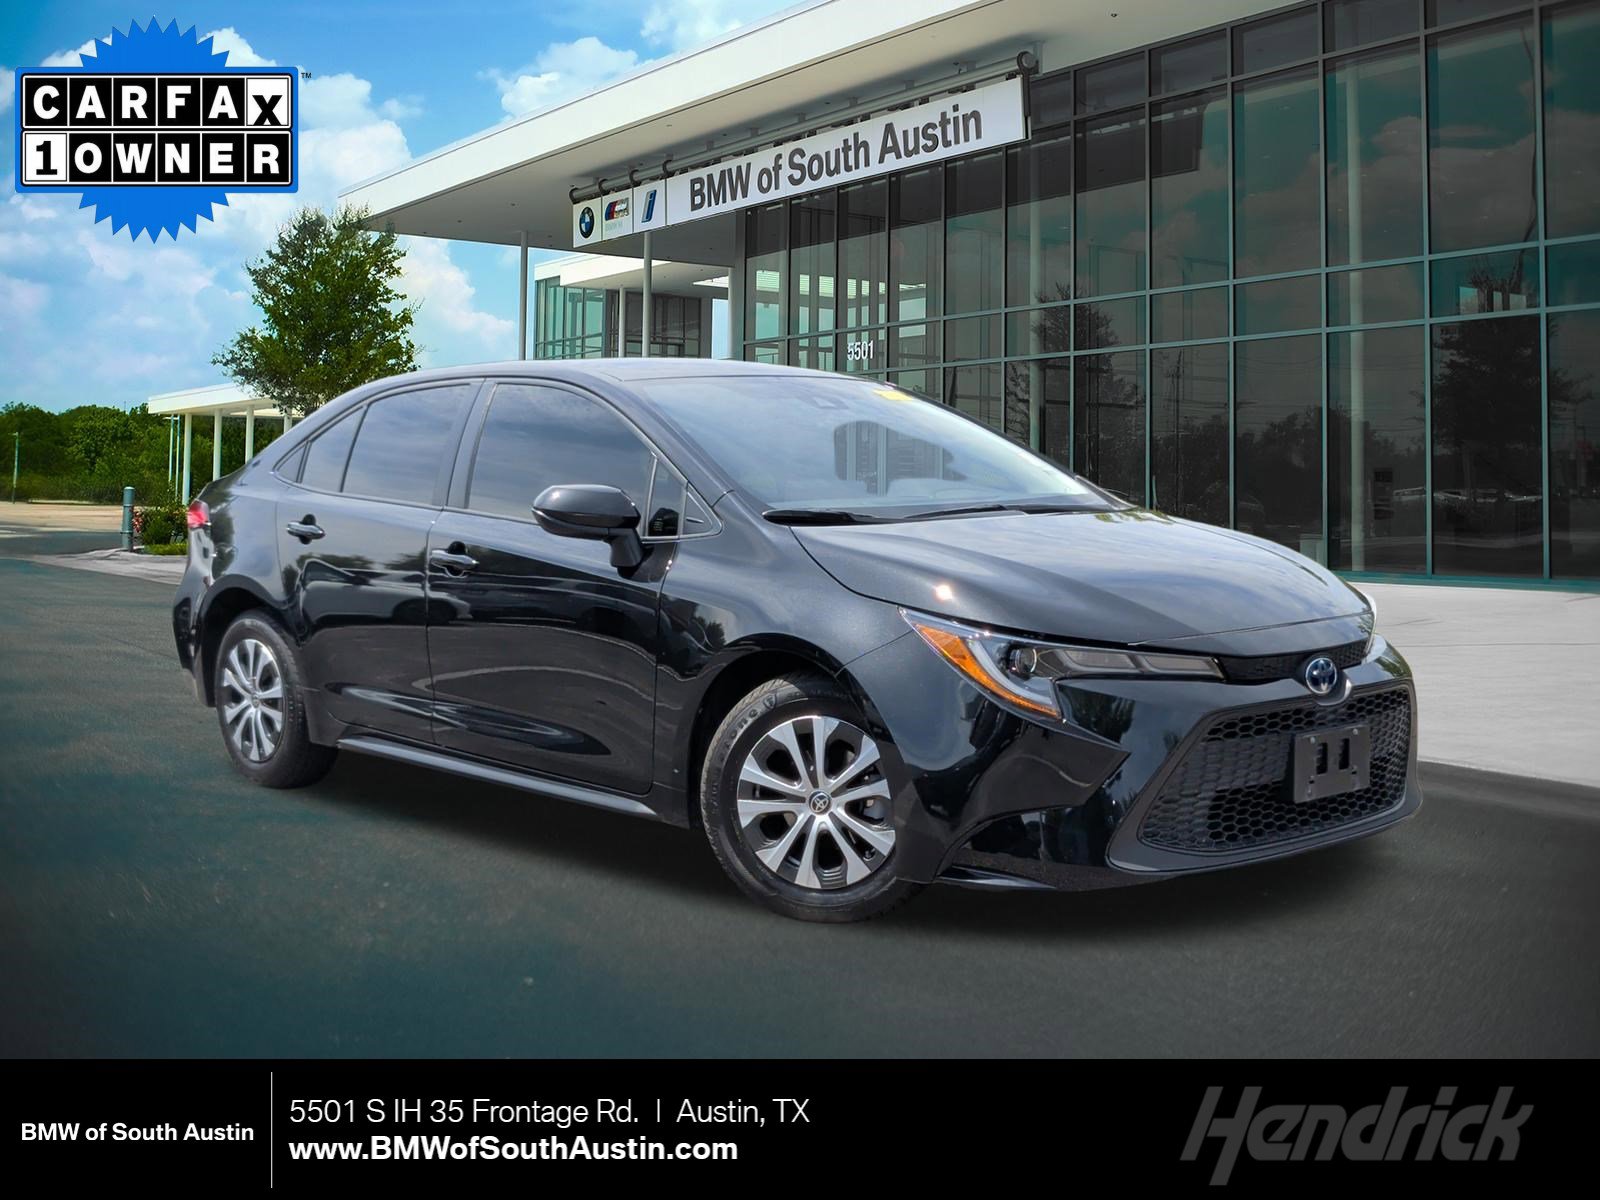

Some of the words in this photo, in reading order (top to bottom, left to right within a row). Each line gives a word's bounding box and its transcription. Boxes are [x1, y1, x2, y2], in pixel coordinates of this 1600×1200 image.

[689, 162, 752, 212] BMW
[757, 153, 783, 194] of
[787, 136, 871, 187] South
[878, 103, 983, 165] Austin
[847, 340, 874, 361] 5501
